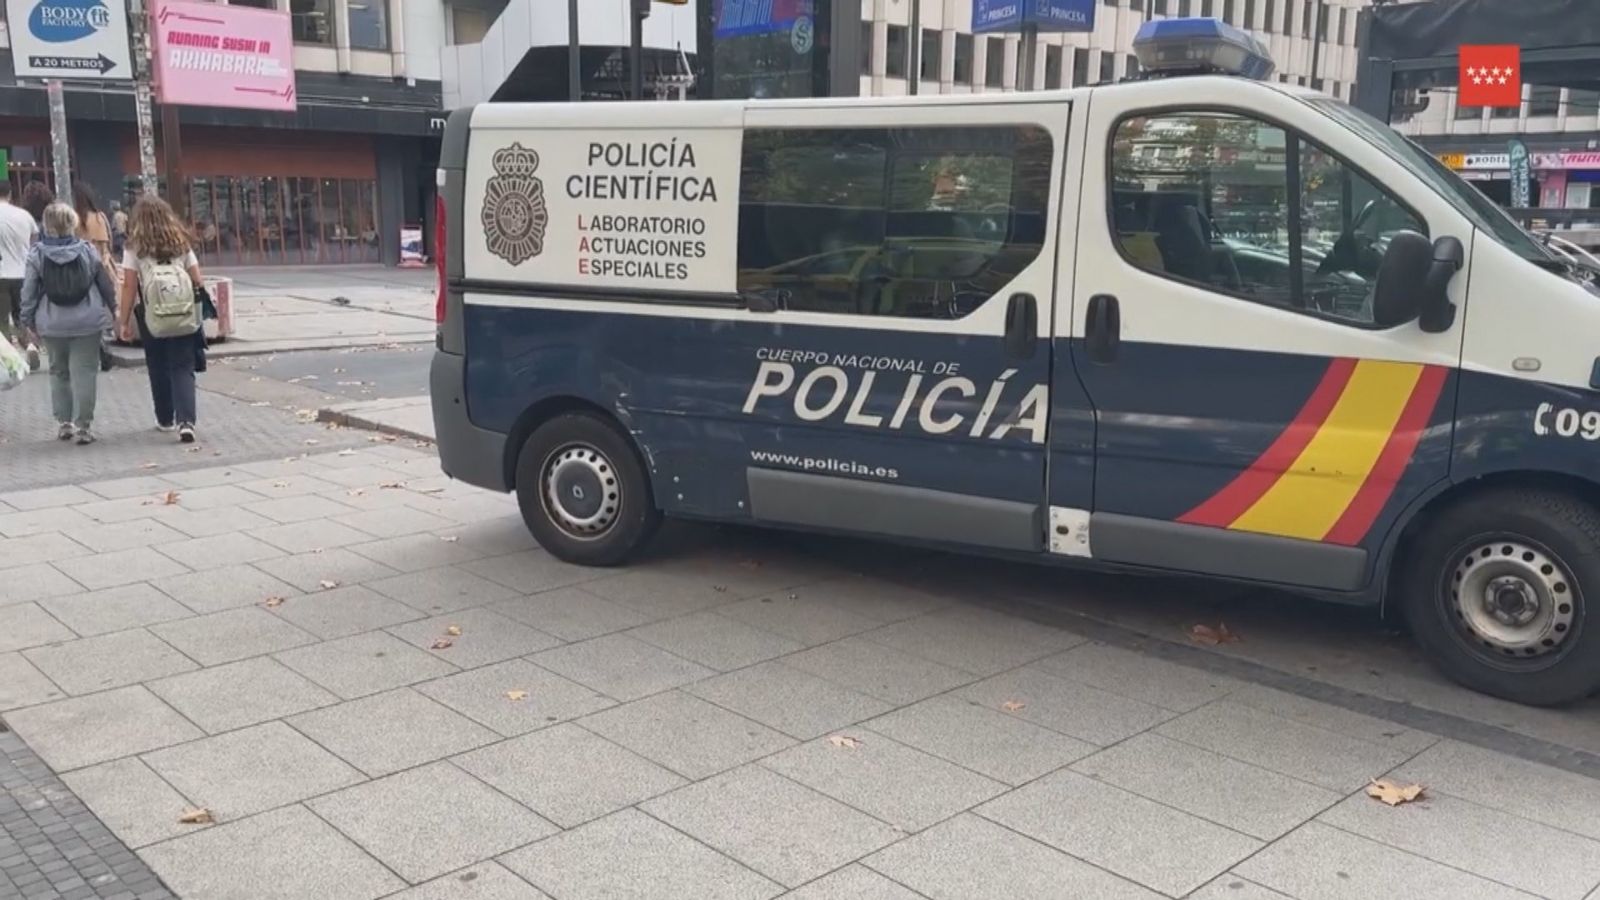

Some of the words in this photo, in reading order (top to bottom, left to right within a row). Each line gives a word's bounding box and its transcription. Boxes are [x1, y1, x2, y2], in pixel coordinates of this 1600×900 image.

[41, 6, 87, 19] BODY
[42, 18, 86, 28] FACTORY
[988, 4, 1017, 21] PRINCESA
[1051, 6, 1087, 24] PRINCESA
[167, 30, 220, 50] RUNNING
[221, 37, 257, 53] SUSHI
[258, 40, 271, 54] IN
[33, 58, 42, 67] A
[44, 58, 58, 67] 20
[61, 59, 104, 69] METROS
[169, 48, 265, 76] AKIHABARA
[588, 137, 696, 168] POLICÍA
[566, 170, 718, 202] CIENTÍFICA
[578, 214, 706, 236] LABORATORIO
[578, 236, 706, 259] ACTUACIONES
[578, 258, 689, 280] ESPECIALES
[756, 347, 829, 366] CUERPO
[832, 354, 927, 374] NACIONAL
[932, 361, 961, 377] DE
[742, 360, 1050, 445] POLICÍA
[750, 450, 900, 479] www.policia.es
